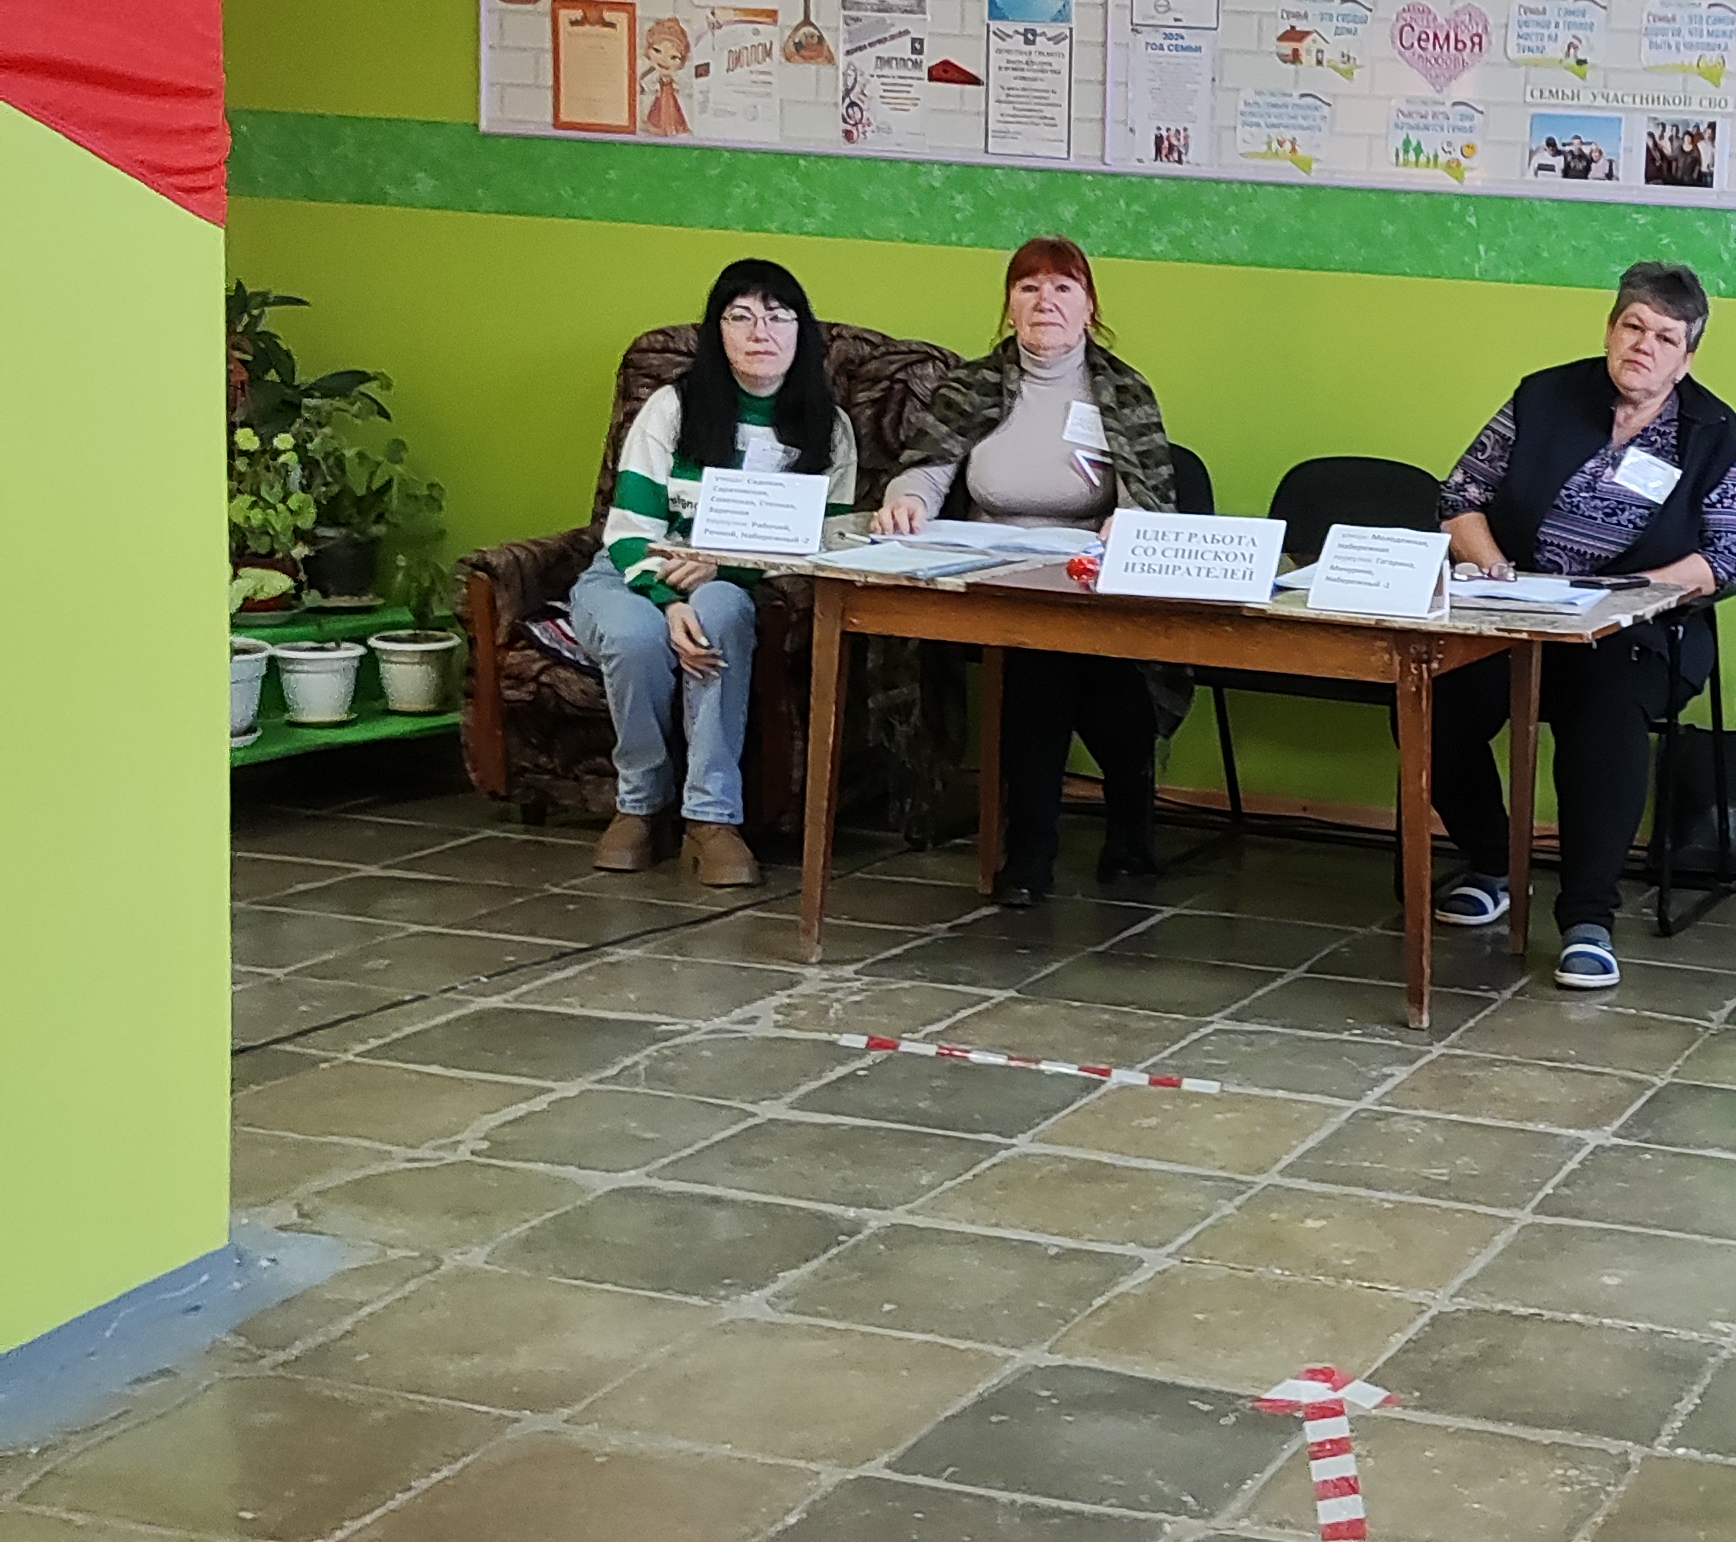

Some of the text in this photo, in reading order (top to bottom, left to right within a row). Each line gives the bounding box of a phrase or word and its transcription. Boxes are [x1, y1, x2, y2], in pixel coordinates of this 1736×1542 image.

[1399, 23, 1483, 53] Семья
[727, 40, 774, 73] ДИПЛОМ
[1145, 42, 1165, 53] ГОД
[875, 56, 923, 71] ДИПЛОМ
[1530, 88, 1728, 109] СЕМЬИ УЧАСТНИКОВ СВО
[1136, 529, 1257, 547] ИДЕТ РАБОТА
[1131, 545, 1254, 563] СО СПИСКОМ
[1124, 562, 1254, 581] ИЗБИРАТЕЛЕЙ
